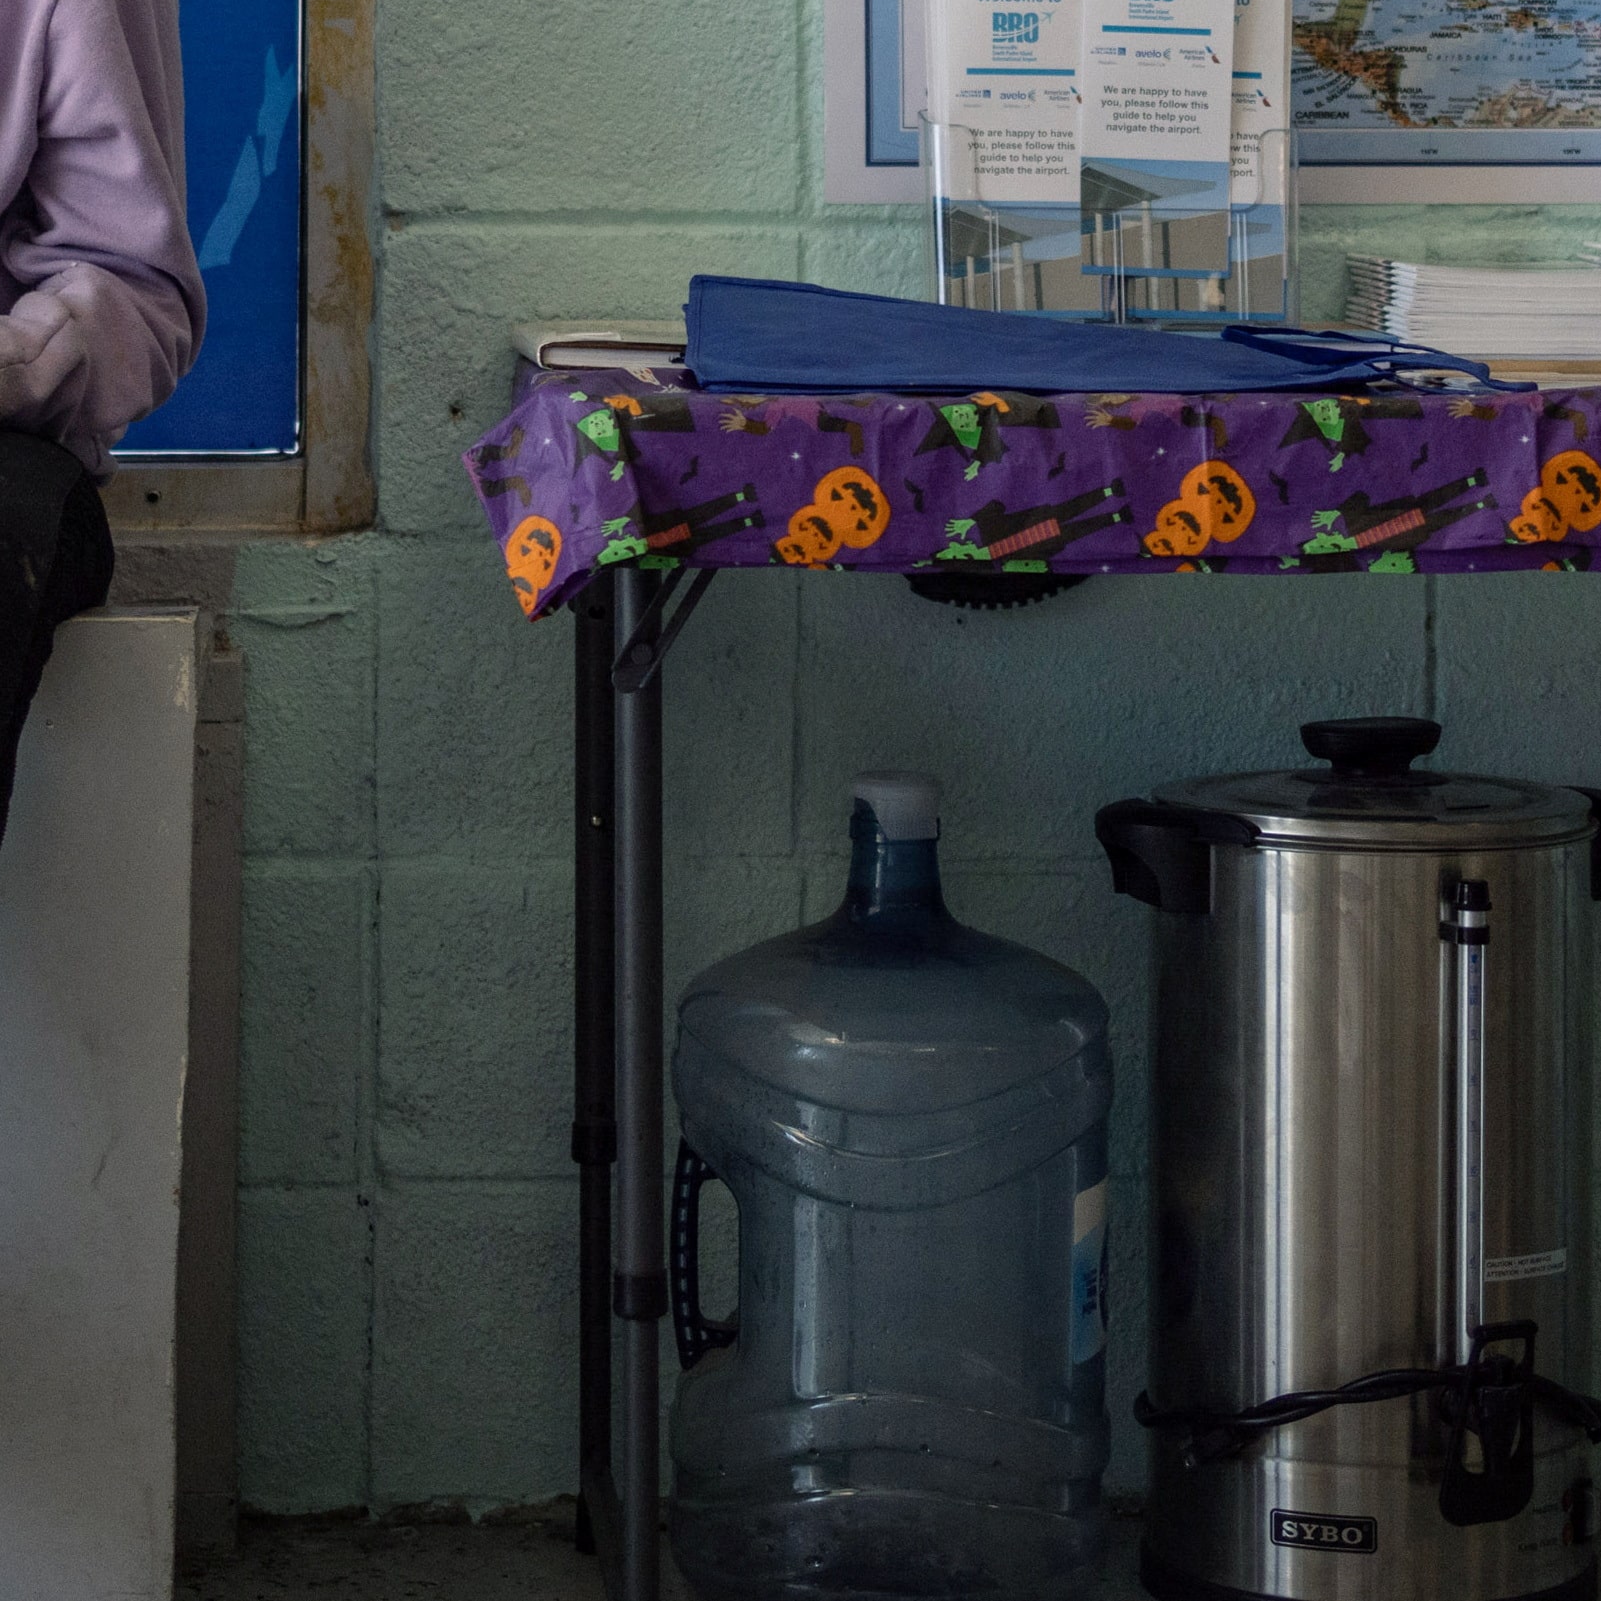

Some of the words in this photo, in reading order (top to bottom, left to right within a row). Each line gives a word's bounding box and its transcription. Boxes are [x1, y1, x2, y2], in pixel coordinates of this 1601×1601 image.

[1135, 49, 1162, 58] avelo
[1103, 85, 1119, 94] We
[1139, 86, 1169, 97] happy
[1172, 88, 1182, 96] to
[1184, 89, 1208, 97] have
[1101, 99, 1122, 108] you,
[1124, 99, 1156, 108] please
[1159, 100, 1188, 109] follow
[1191, 101, 1209, 110] this
[1113, 111, 1140, 121] guide
[1142, 112, 1153, 120] to
[1155, 112, 1176, 122] help
[1178, 114, 1197, 123] you
[970, 128, 984, 137] We
[987, 129, 1003, 137] are
[1005, 129, 1035, 139] happy
[1037, 129, 1048, 137] to
[1050, 129, 1074, 138] have
[1106, 123, 1147, 134] navigate
[1149, 124, 1165, 133] the
[1167, 125, 1202, 135] airport.
[1236, 132, 1260, 140] have
[991, 142, 1022, 151] please
[1025, 142, 1055, 150] follow
[1057, 142, 1076, 151] this
[1243, 144, 1261, 152] this
[980, 153, 1007, 163] guide
[1009, 154, 1020, 162] to
[1022, 154, 1043, 164] help
[1045, 155, 1064, 164] you
[973, 166, 1015, 176] navigate
[1017, 166, 1033, 174] the
[1035, 166, 1069, 176] airport.
[1230, 168, 1254, 178] rport.
[1282, 1520, 1363, 1545] SYBO
